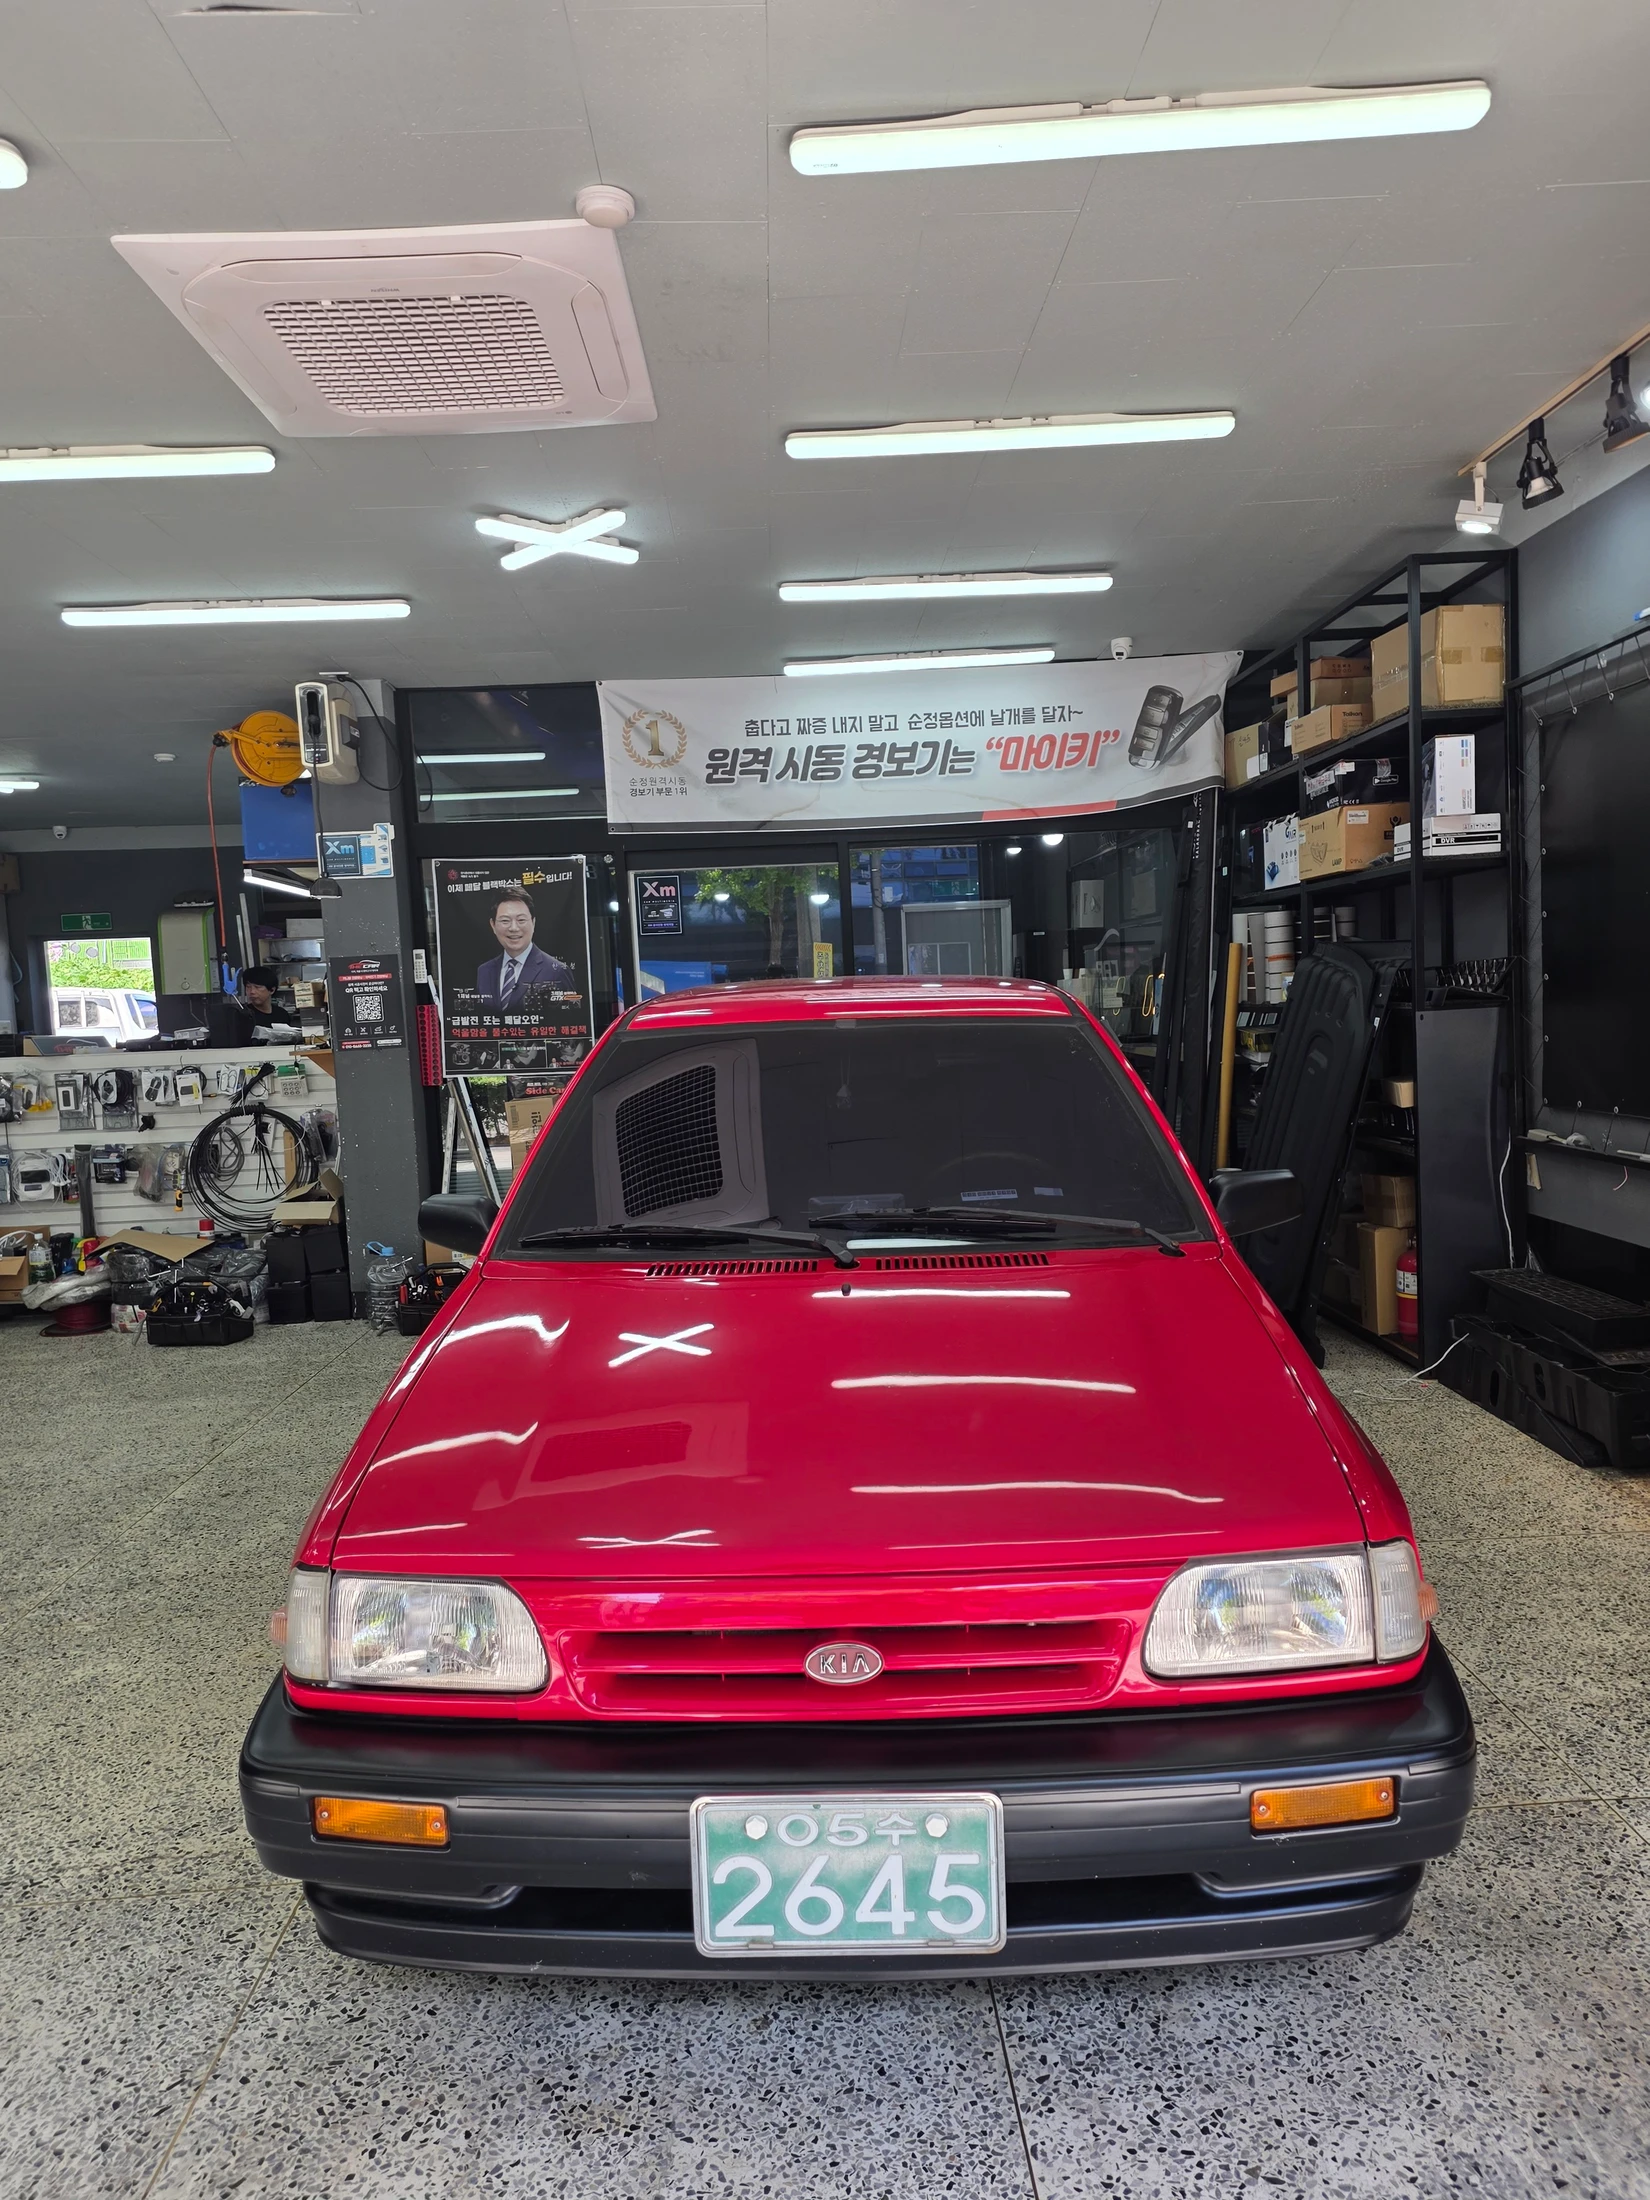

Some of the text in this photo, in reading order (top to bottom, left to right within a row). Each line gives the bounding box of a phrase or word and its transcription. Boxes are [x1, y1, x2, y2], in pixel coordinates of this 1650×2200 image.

[744, 705, 1084, 737] 춥다고 짜증 내지 말고 순정옵션에 날개를 달자~
[645, 719, 665, 757] 1
[705, 729, 1121, 784] 원격 시동 경보기는 “마이키”
[629, 776, 687, 787] 순정원격시동
[629, 786, 688, 798] 경보기 부문 1위
[325, 841, 355, 855] Xm
[447, 883, 463, 893] 이제
[482, 878, 522, 890] 블랙박스는
[522, 870, 573, 885] 필수입니다!
[642, 881, 676, 897] Xm
[483, 1016, 501, 1025] 또는
[530, 1026, 557, 1036] 유일한
[560, 1025, 587, 1035] 해결책
[525, 1087, 547, 1095] Side
[819, 1653, 871, 1673] KIA
[777, 1812, 918, 1847] 05수
[712, 1853, 986, 1937] 2645
